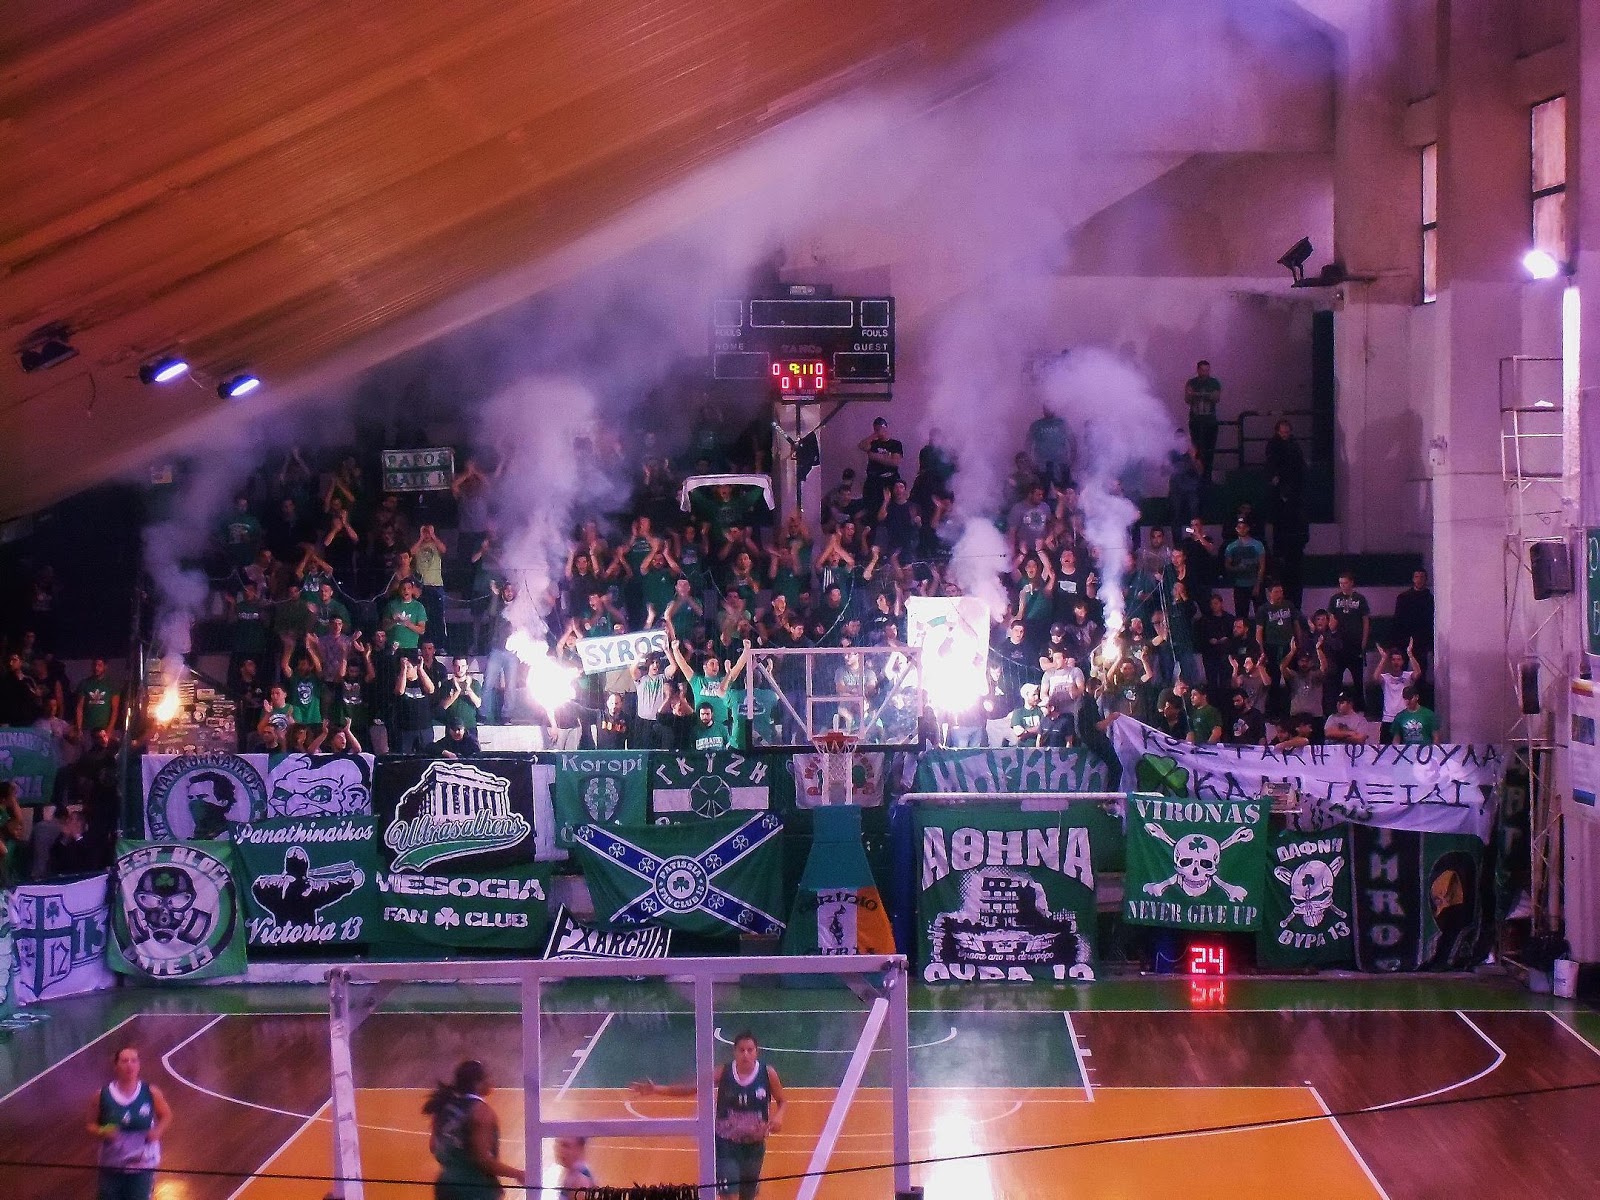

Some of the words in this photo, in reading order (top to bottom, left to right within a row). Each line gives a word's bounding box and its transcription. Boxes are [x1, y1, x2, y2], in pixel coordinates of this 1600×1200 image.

[861, 329, 889, 337] FOULS
[853, 343, 888, 351] GUEST
[584, 633, 667, 667] SYROS
[561, 753, 643, 775] Koropi
[1134, 799, 1261, 824] VIRONAS
[234, 820, 374, 844] Panathinaikos
[118, 847, 162, 879] EST
[171, 847, 229, 890] BLOCK
[659, 860, 702, 879] PATISSIA
[376, 871, 546, 900] MESOGIA
[658, 887, 674, 904] FAN
[673, 895, 700, 908] CLUB
[383, 907, 428, 924] FAN
[464, 911, 529, 928] CLUB
[1128, 900, 1182, 922] NEVER
[1187, 904, 1228, 924] GIVE
[1234, 905, 1258, 925] UP
[245, 916, 337, 946] Victoria
[341, 916, 364, 941] 13
[550, 914, 669, 958] EXARCHIA
[1328, 921, 1351, 940] 13
[1191, 947, 1224, 974] 24
